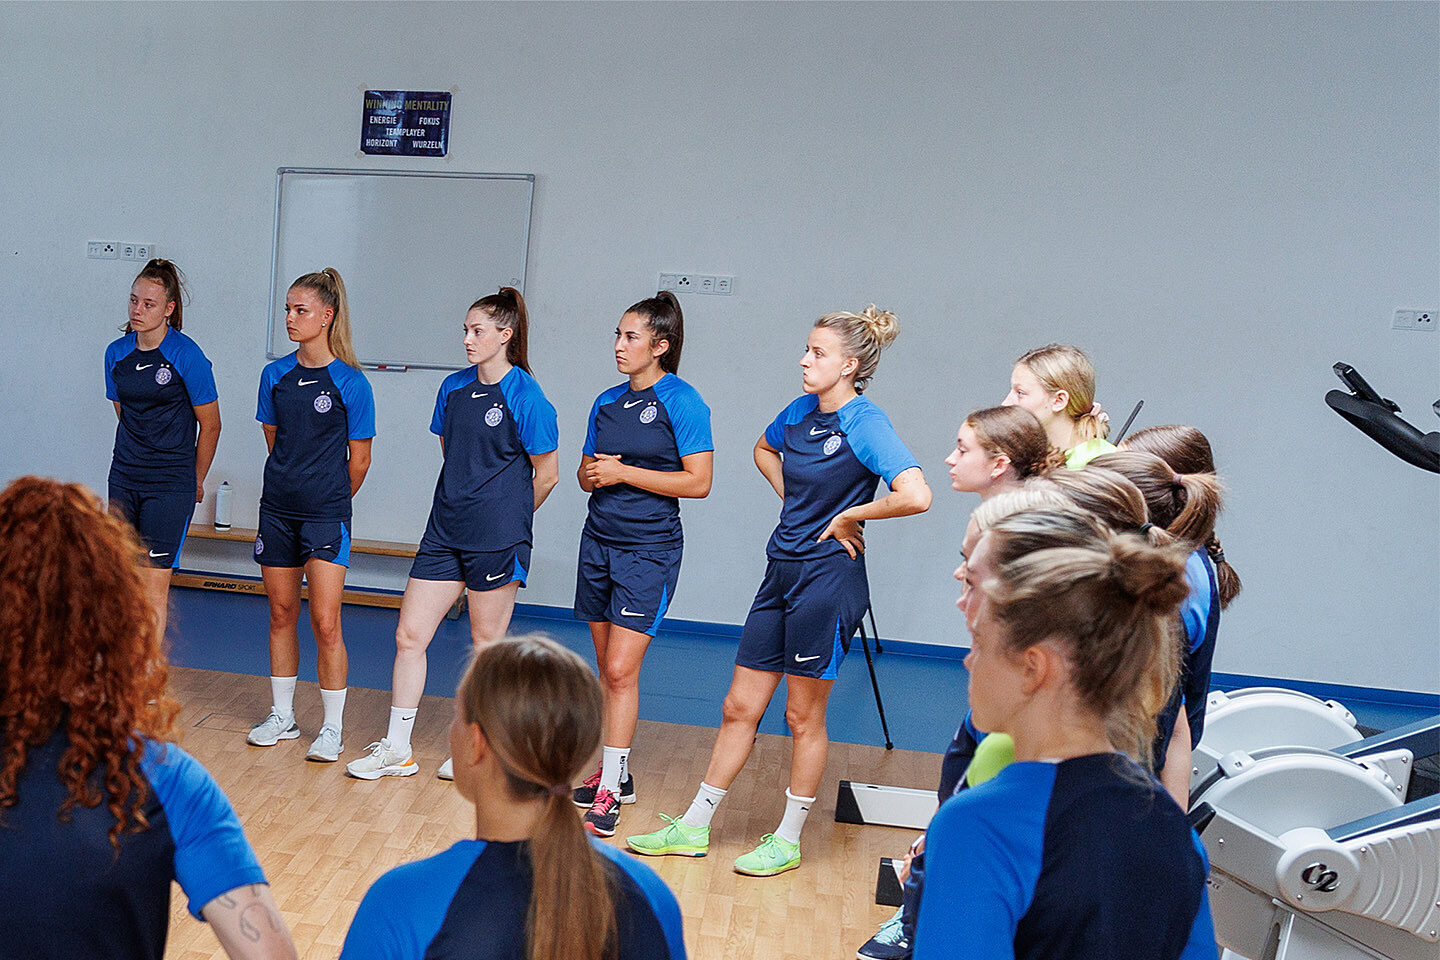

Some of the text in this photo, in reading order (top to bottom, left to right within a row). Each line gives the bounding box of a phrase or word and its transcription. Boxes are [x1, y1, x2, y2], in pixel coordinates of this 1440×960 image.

[405, 100, 450, 111] MENTALITY
[369, 116, 441, 126] ENERGIE FOKUS
[385, 127, 426, 137] TEAMPLAYER
[365, 138, 443, 149] HORIZONT WURZELN
